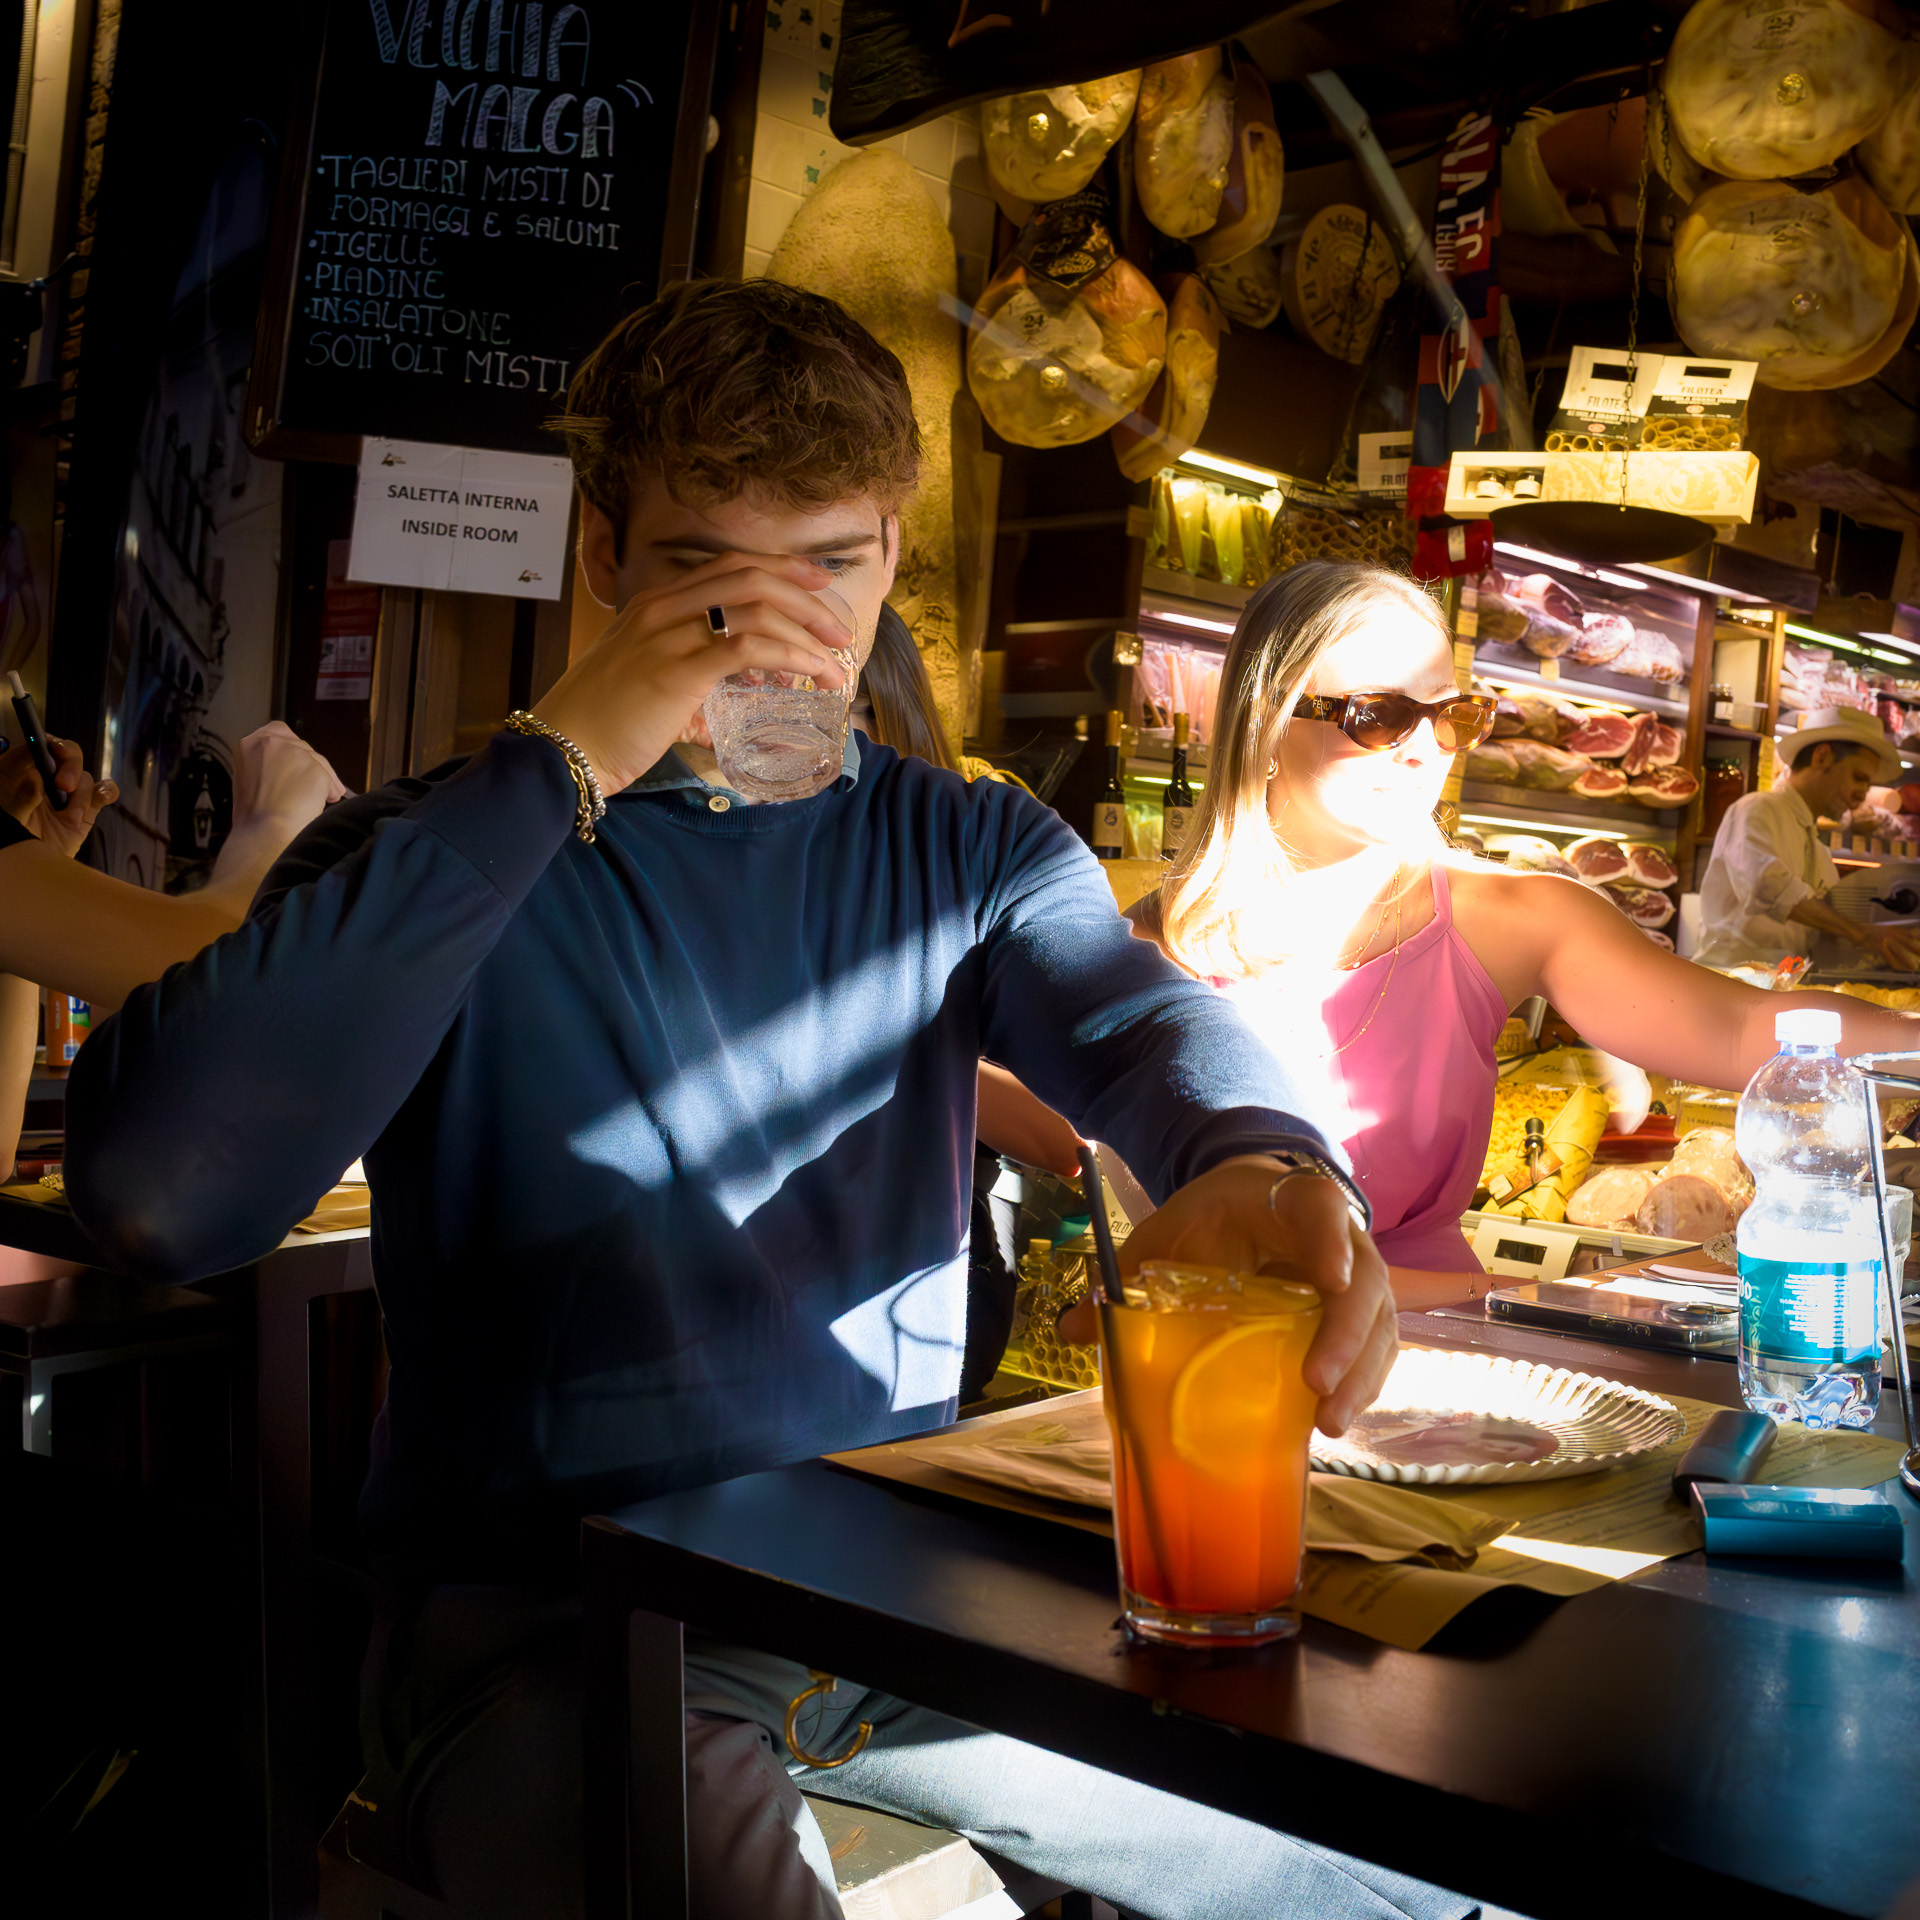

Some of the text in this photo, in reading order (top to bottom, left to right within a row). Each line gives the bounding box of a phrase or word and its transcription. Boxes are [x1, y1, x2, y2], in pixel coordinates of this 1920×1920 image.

[370, 0, 590, 86] VECCHIA
[320, 154, 614, 210] TAGLIERI MISTI DI
[330, 195, 620, 250] FORMAGGI E SALUMI
[315, 230, 436, 265] TIGELLE
[315, 262, 445, 299] PIADINE
[311, 297, 511, 345] INSALATONE
[305, 331, 569, 392] SOTT'OLI MISTI
[1681, 385, 1723, 396] FILOTEA
[387, 484, 539, 513] SALETTA INTERNA
[402, 519, 518, 544] INSIDE ROOM
[1312, 699, 1333, 711] FENDI
